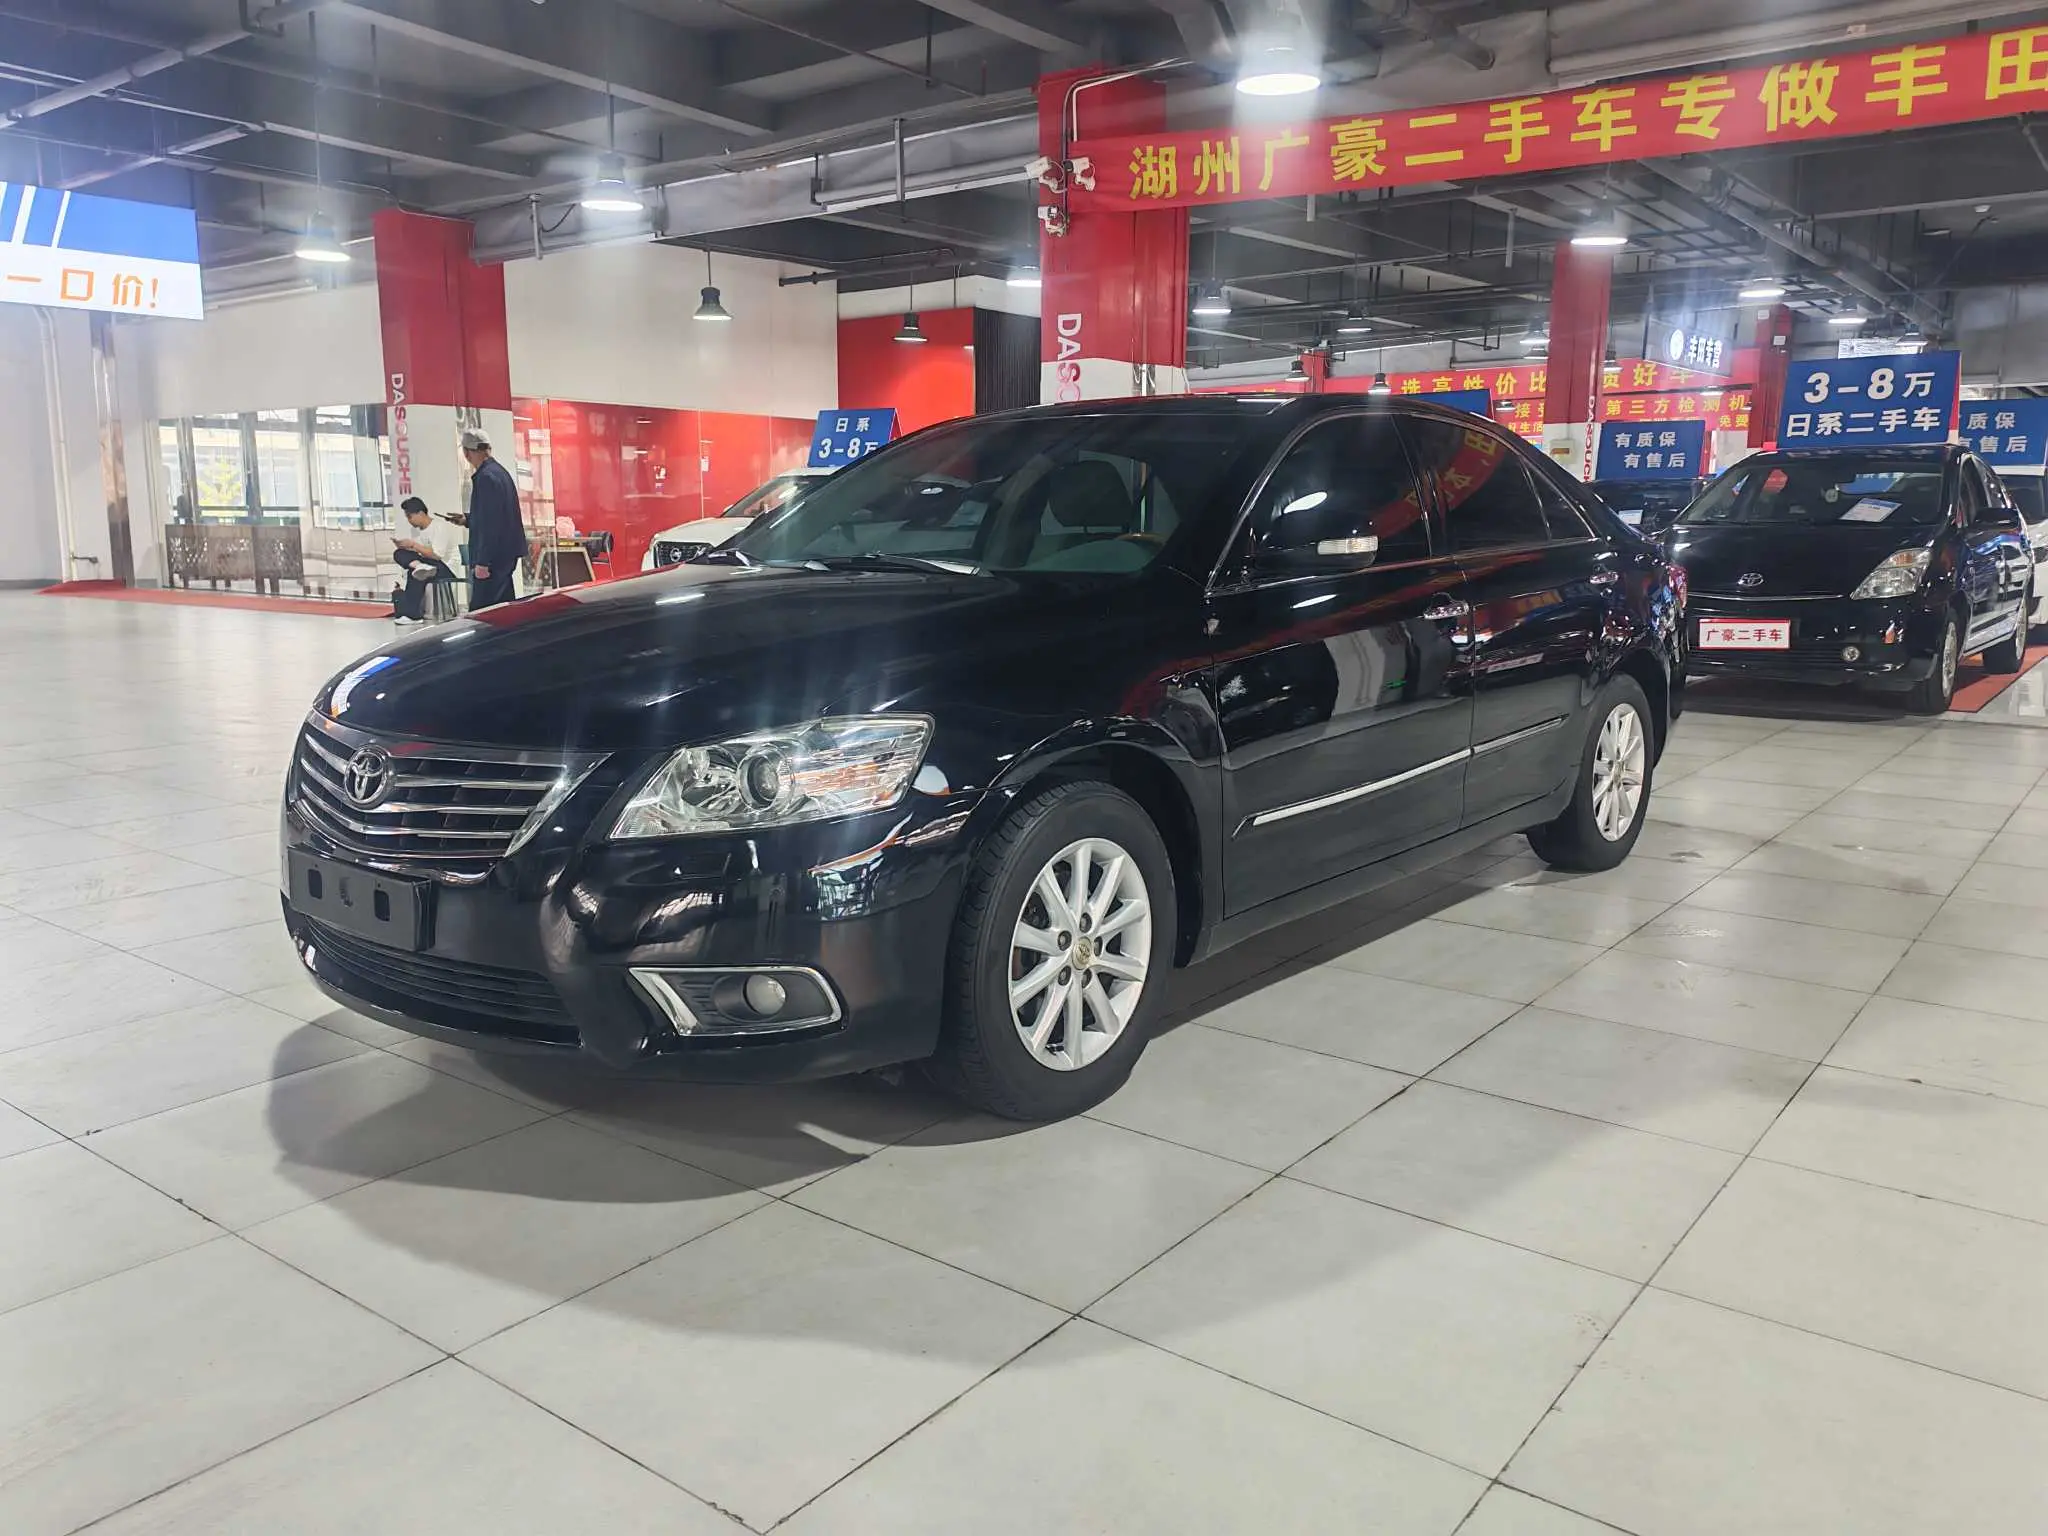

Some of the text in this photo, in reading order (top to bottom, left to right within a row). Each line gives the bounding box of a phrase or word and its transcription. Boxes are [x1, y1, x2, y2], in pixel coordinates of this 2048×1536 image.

[1130, 26, 2048, 200] 湖州广豪二手车专做丰田
[835, 417, 870, 432] 日系
[1786, 407, 1941, 437] 日系二手车
[1959, 412, 2016, 430] 质保
[391, 373, 412, 495] DASOUCHE
[1615, 431, 1676, 448] 有质保
[1624, 452, 1687, 468] 有售后
[1706, 628, 1782, 642] 广豪二手车
